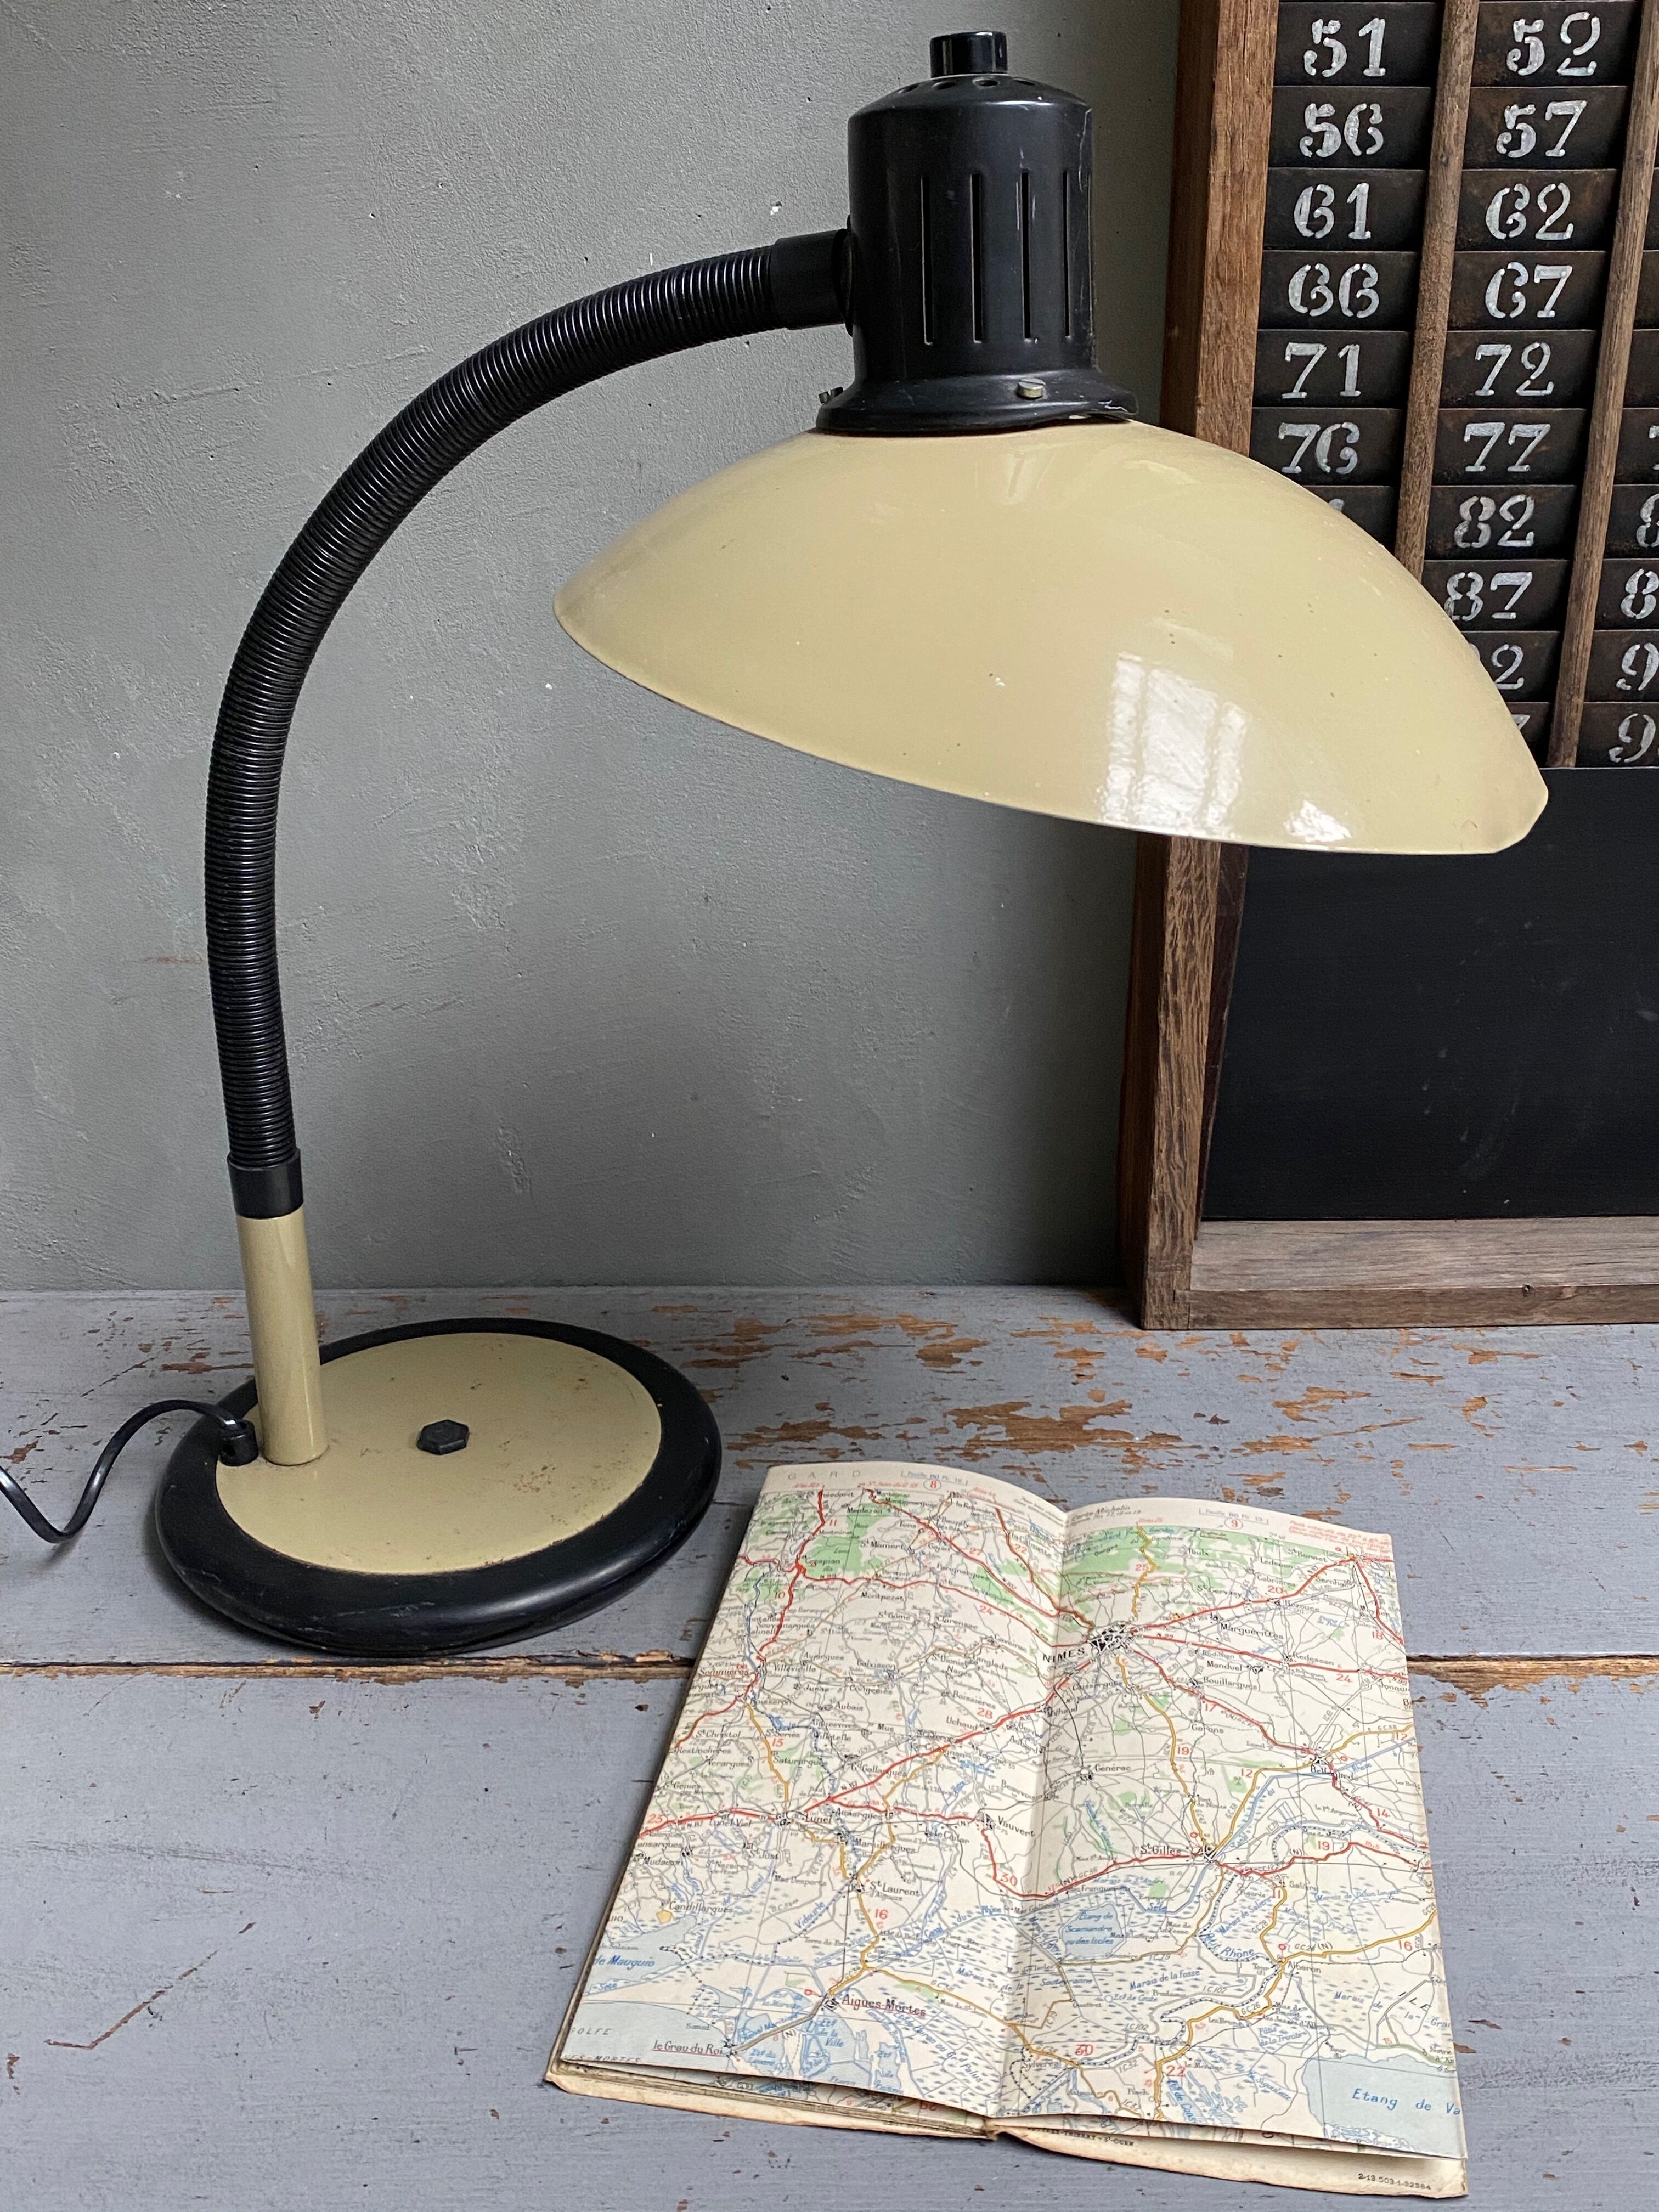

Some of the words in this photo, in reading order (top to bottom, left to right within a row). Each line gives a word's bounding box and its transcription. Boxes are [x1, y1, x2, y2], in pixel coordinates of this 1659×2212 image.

[1304, 18, 1386, 77] 51
[1506, 12, 1600, 76] 52
[1299, 103, 1384, 157] 56
[1496, 100, 1587, 158] 57
[1294, 182, 1371, 238] 61
[1485, 183, 1573, 240] 62
[1288, 263, 1379, 318] 66
[1485, 262, 1573, 318] 67
[1281, 342, 1361, 398] 71
[1475, 342, 1554, 396] 72
[1278, 422, 1360, 473] 76
[1464, 422, 1551, 472] 77
[1454, 494, 1534, 548] 82
[1443, 571, 1532, 621] 87
[1620, 568, 1659, 619] 8
[1609, 713, 1659, 763] 9
[1015, 1545, 1028, 1554] 22
[979, 1606, 994, 1615] 24
[1372, 1631, 1383, 1640] 18
[1043, 1647, 1085, 1663] NIMES
[1336, 1674, 1352, 1683] 24
[977, 1707, 992, 1718] 28
[1205, 1703, 1216, 1712] 17
[772, 1738, 783, 1747] 15
[1177, 1747, 1190, 1755] 19
[1241, 1768, 1252, 1778] 12
[1377, 1808, 1390, 1817] 14
[1318, 1841, 1330, 1850] 19
[1001, 1874, 1018, 1885] 30
[875, 1909, 888, 1919] 16
[1399, 1940, 1412, 1951] 16
[841, 1994, 927, 2017] Aigues-Mortes
[1166, 2064, 1186, 2077] 22
[1352, 2088, 1398, 2111] Etang
[1415, 2098, 1431, 2111] de
[1446, 2103, 1460, 2115] Va
